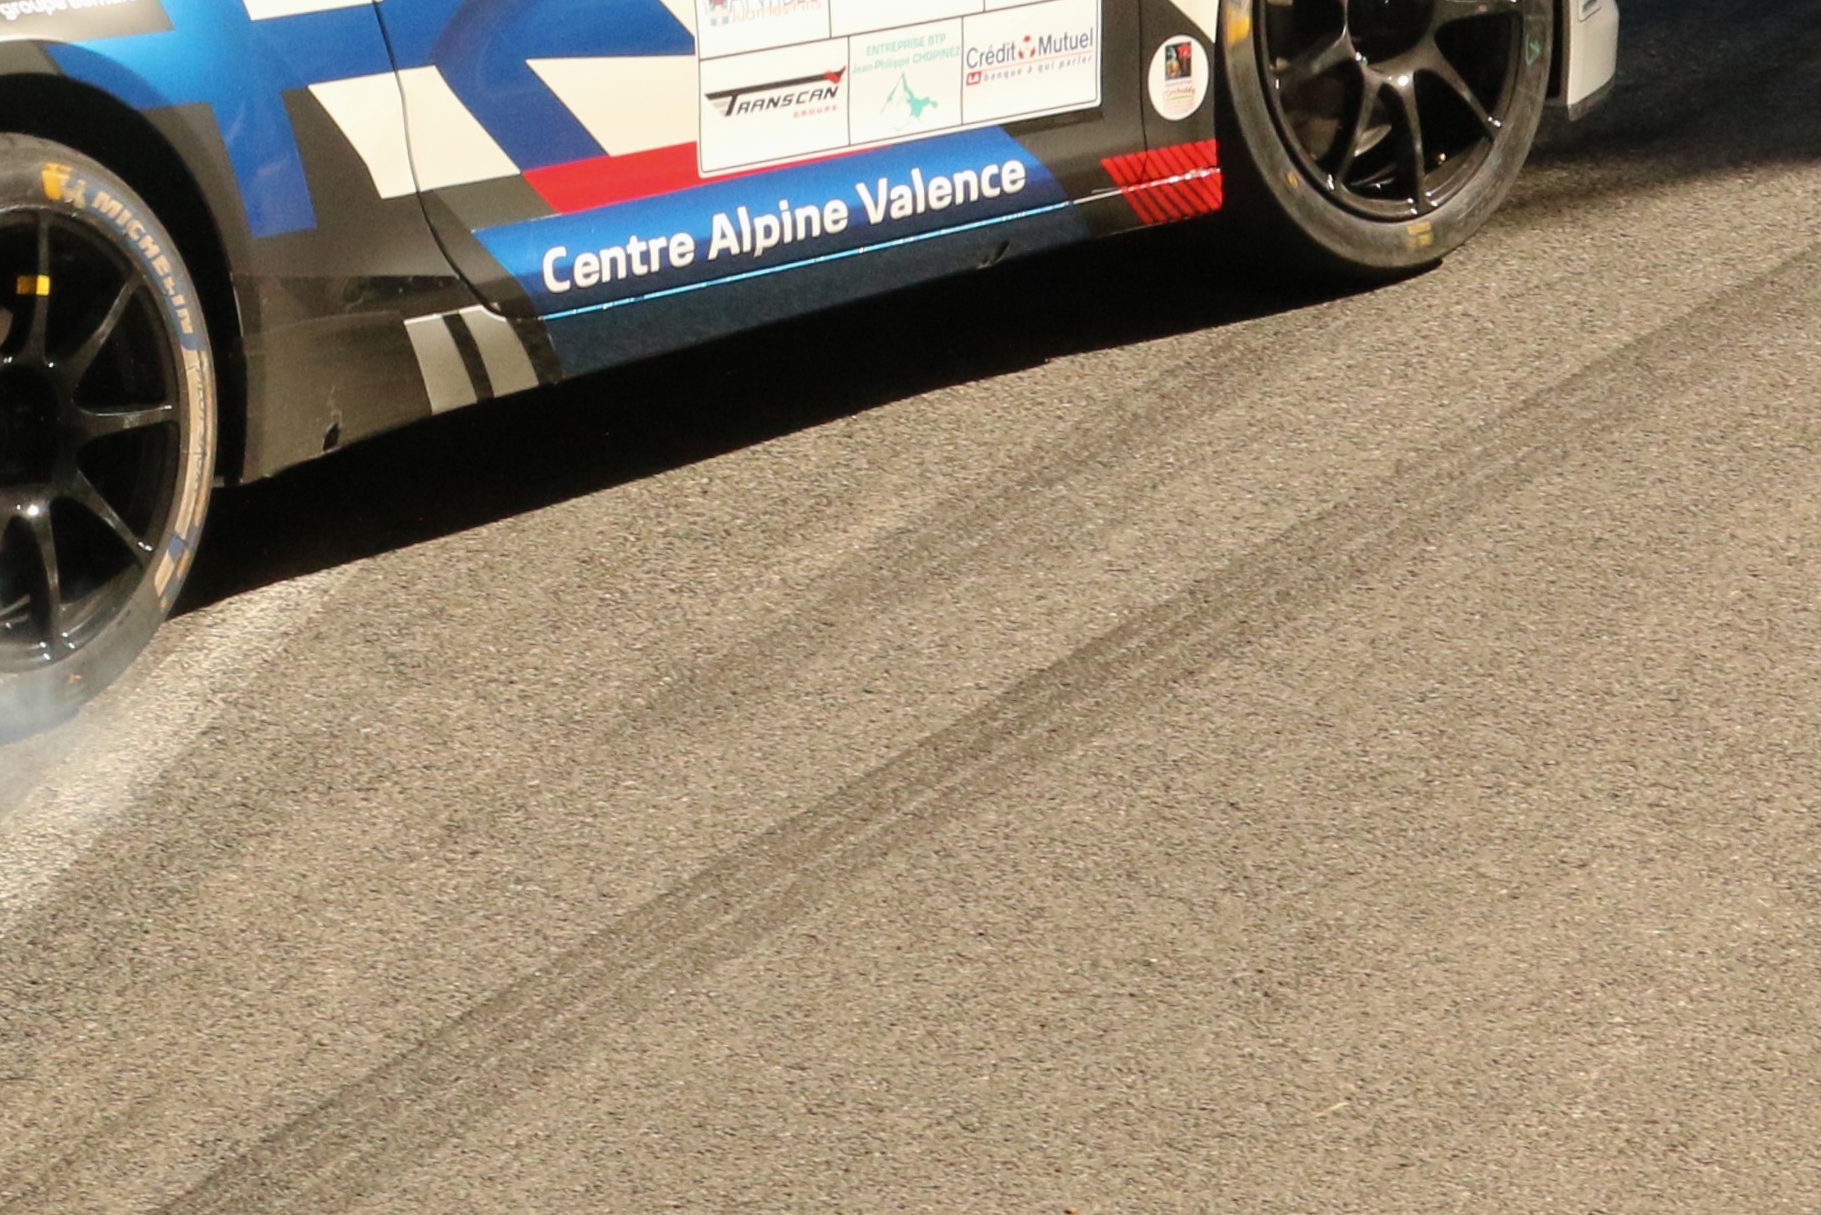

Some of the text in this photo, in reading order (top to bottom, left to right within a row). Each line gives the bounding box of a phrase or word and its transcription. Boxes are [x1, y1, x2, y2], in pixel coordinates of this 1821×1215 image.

[865, 33, 946, 57] ENTREPRISE BTP
[966, 26, 1094, 69] Crédit Mutuel
[716, 82, 840, 118] TRANSCAN
[792, 103, 839, 119] GROUPE
[543, 158, 1027, 294] Centre Alpine Valence
[92, 190, 196, 335] MICHELIN
